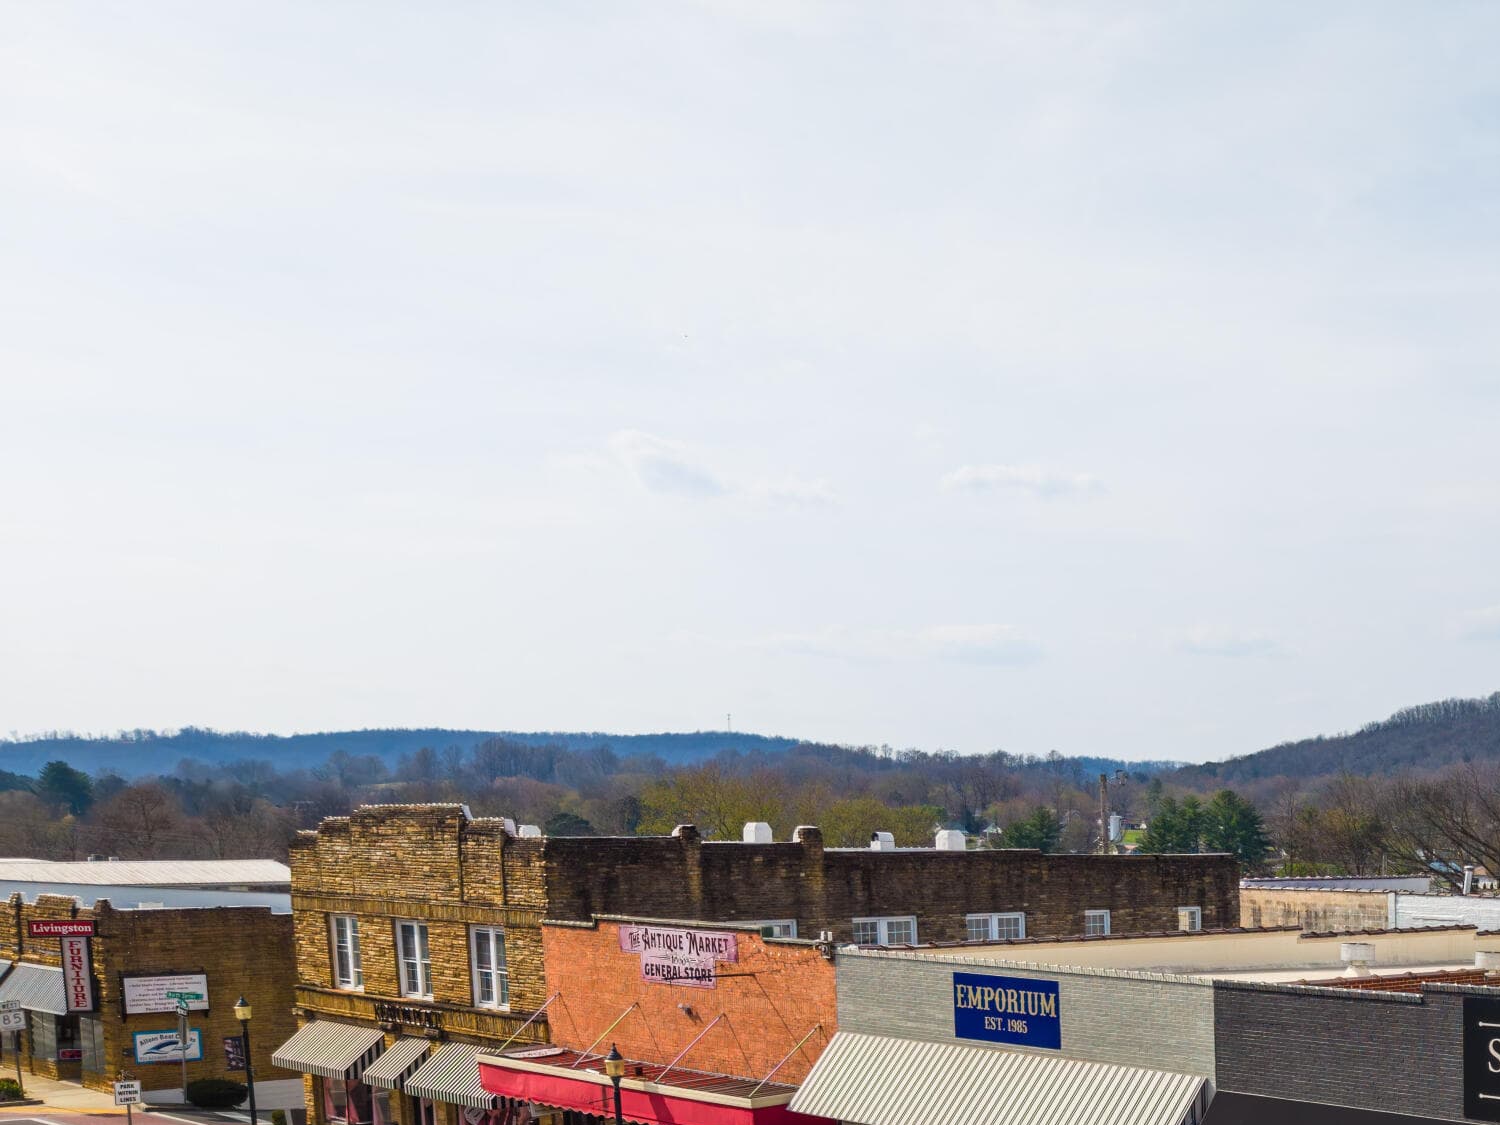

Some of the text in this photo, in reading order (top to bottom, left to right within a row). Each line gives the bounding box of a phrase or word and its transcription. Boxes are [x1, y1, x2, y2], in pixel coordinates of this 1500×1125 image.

[32, 924, 92, 934] Livingston
[629, 932, 640, 948] THE
[68, 940, 88, 1008] FURNITURE
[644, 963, 712, 982] GENERAL STORE
[956, 985, 1057, 1018] EMPORIUM
[2, 1013, 22, 1026] 85
[984, 1016, 1028, 1034] EST. 1985
